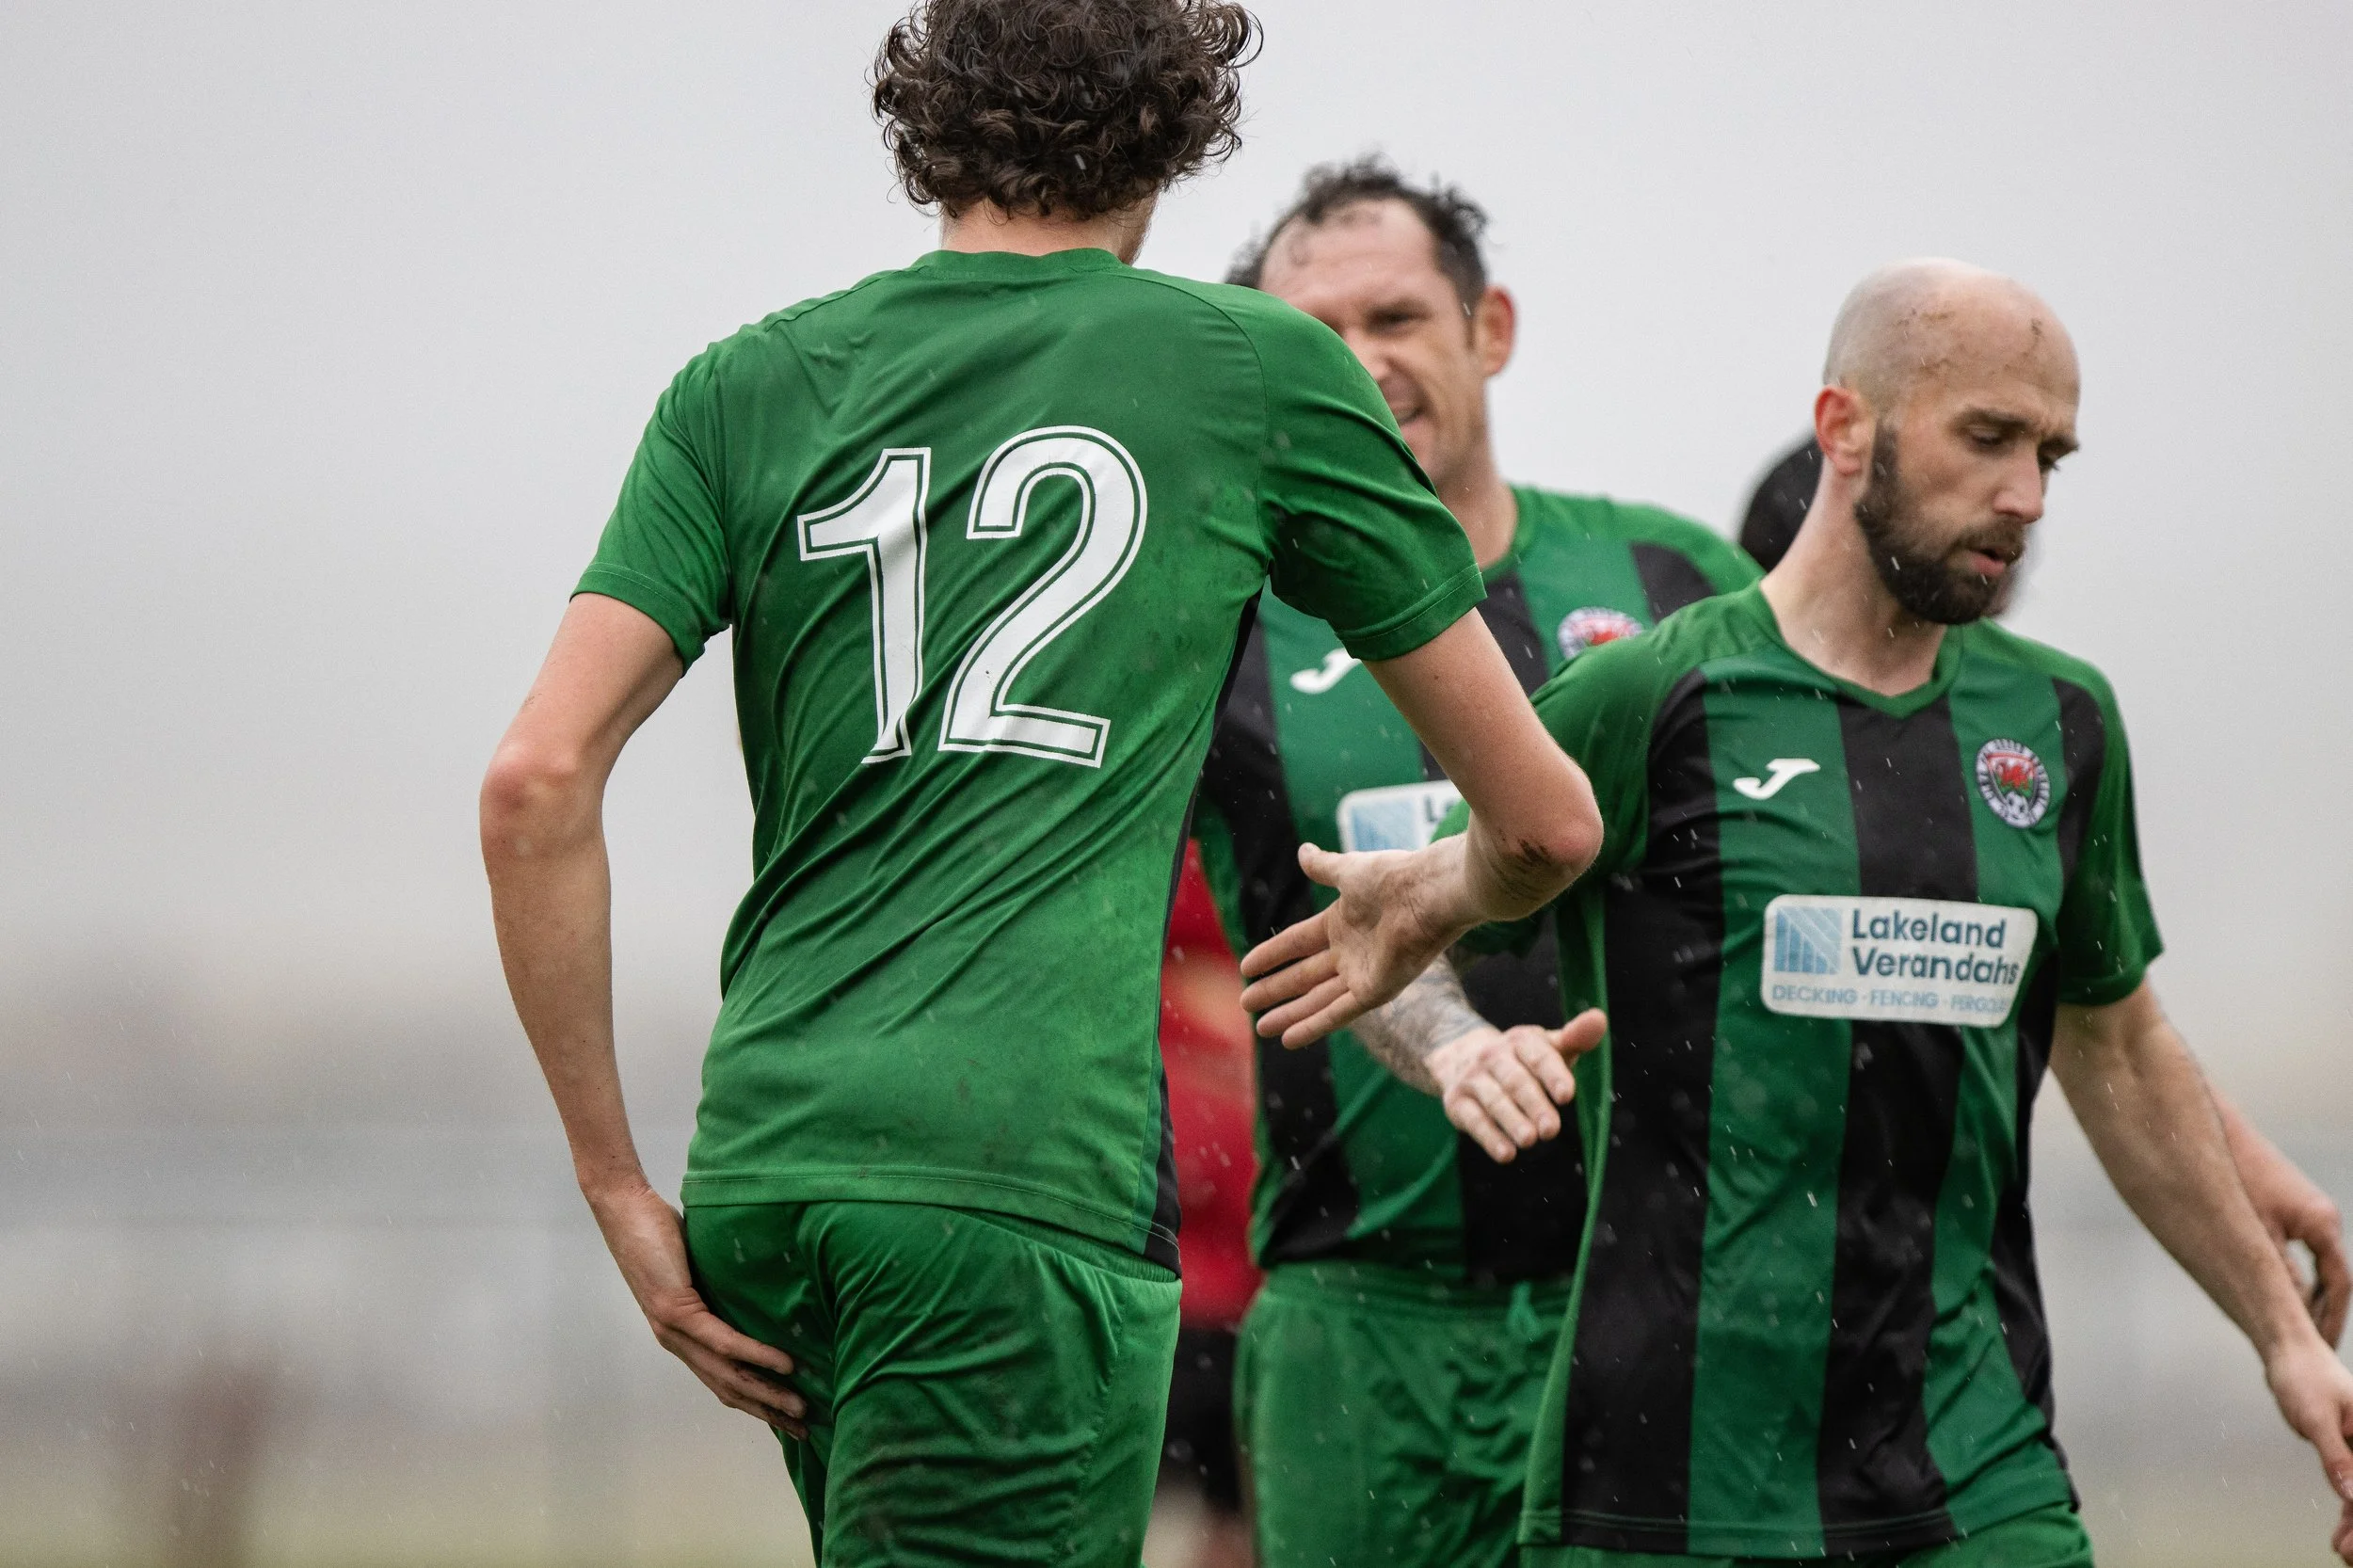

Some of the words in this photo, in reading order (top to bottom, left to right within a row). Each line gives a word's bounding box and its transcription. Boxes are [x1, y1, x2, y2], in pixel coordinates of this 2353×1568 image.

[796, 424, 1148, 769] 12
[1851, 908, 2007, 949] Lakeland
[1851, 946, 2020, 984] Verandahs
[1772, 984, 1858, 1004] DECKING
